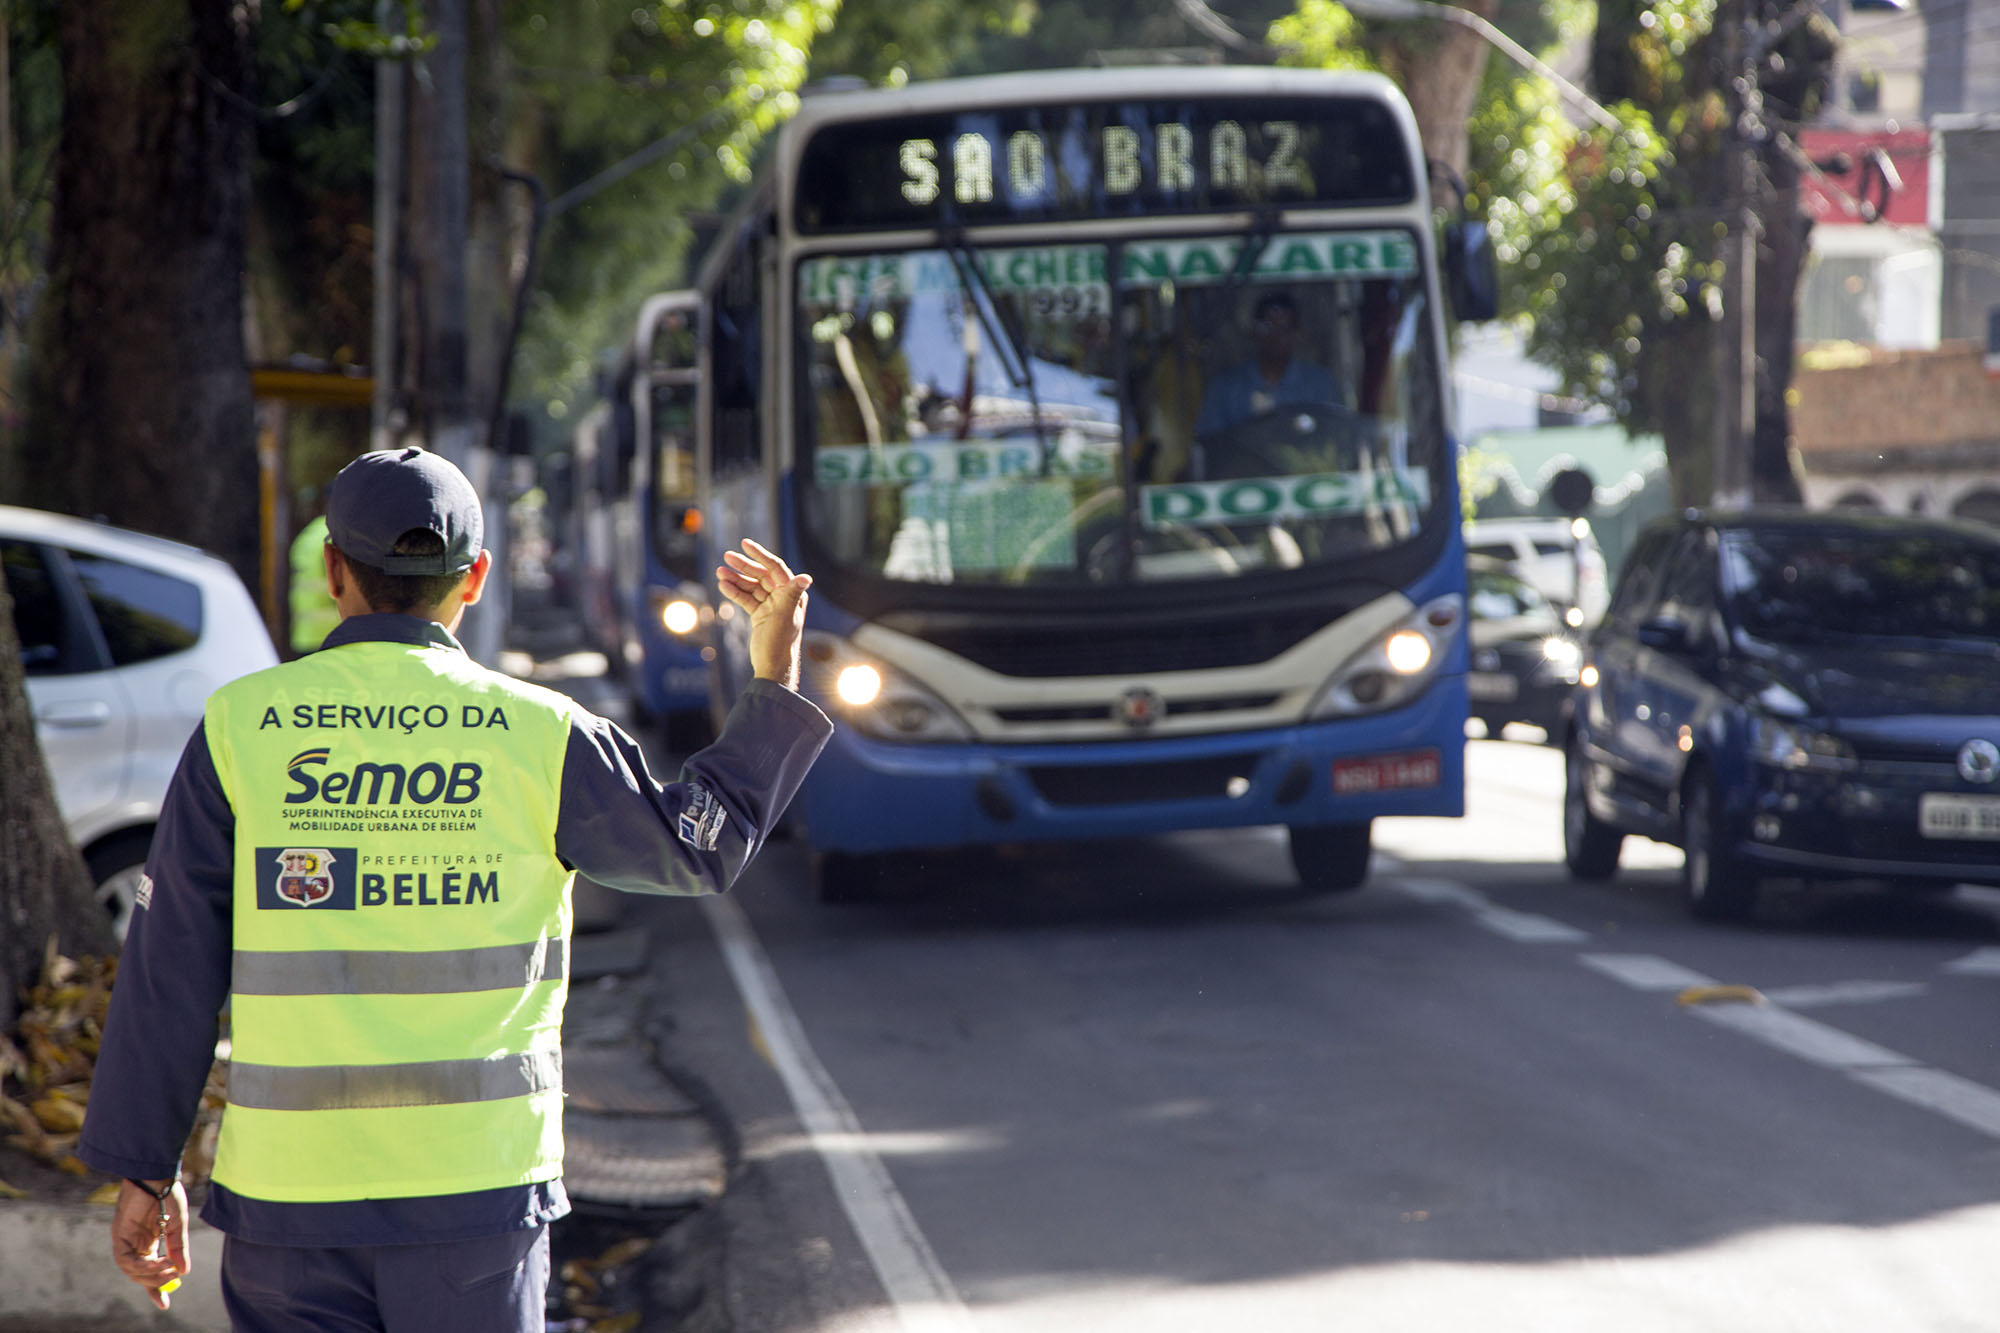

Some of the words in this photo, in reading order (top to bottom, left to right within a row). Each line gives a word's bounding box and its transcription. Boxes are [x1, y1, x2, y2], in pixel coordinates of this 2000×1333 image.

[1104, 120, 1300, 195] BRAZ
[917, 246, 1107, 287] MLCHER
[1151, 473, 1420, 521] DOCA
[259, 705, 282, 730] A
[292, 704, 449, 734] SERVIÇO
[462, 705, 510, 730] DA
[281, 807, 399, 820] SUPERINTENDÊNCIA
[403, 808, 466, 820] EXECUTIVA
[470, 808, 483, 819] DE
[289, 819, 364, 832] MOBILIDADE
[368, 820, 418, 832] URBANA
[422, 821, 436, 832] DE
[363, 854, 478, 866] PREFEITURA
[486, 853, 503, 864] DE
[361, 867, 500, 906] BELÉM
